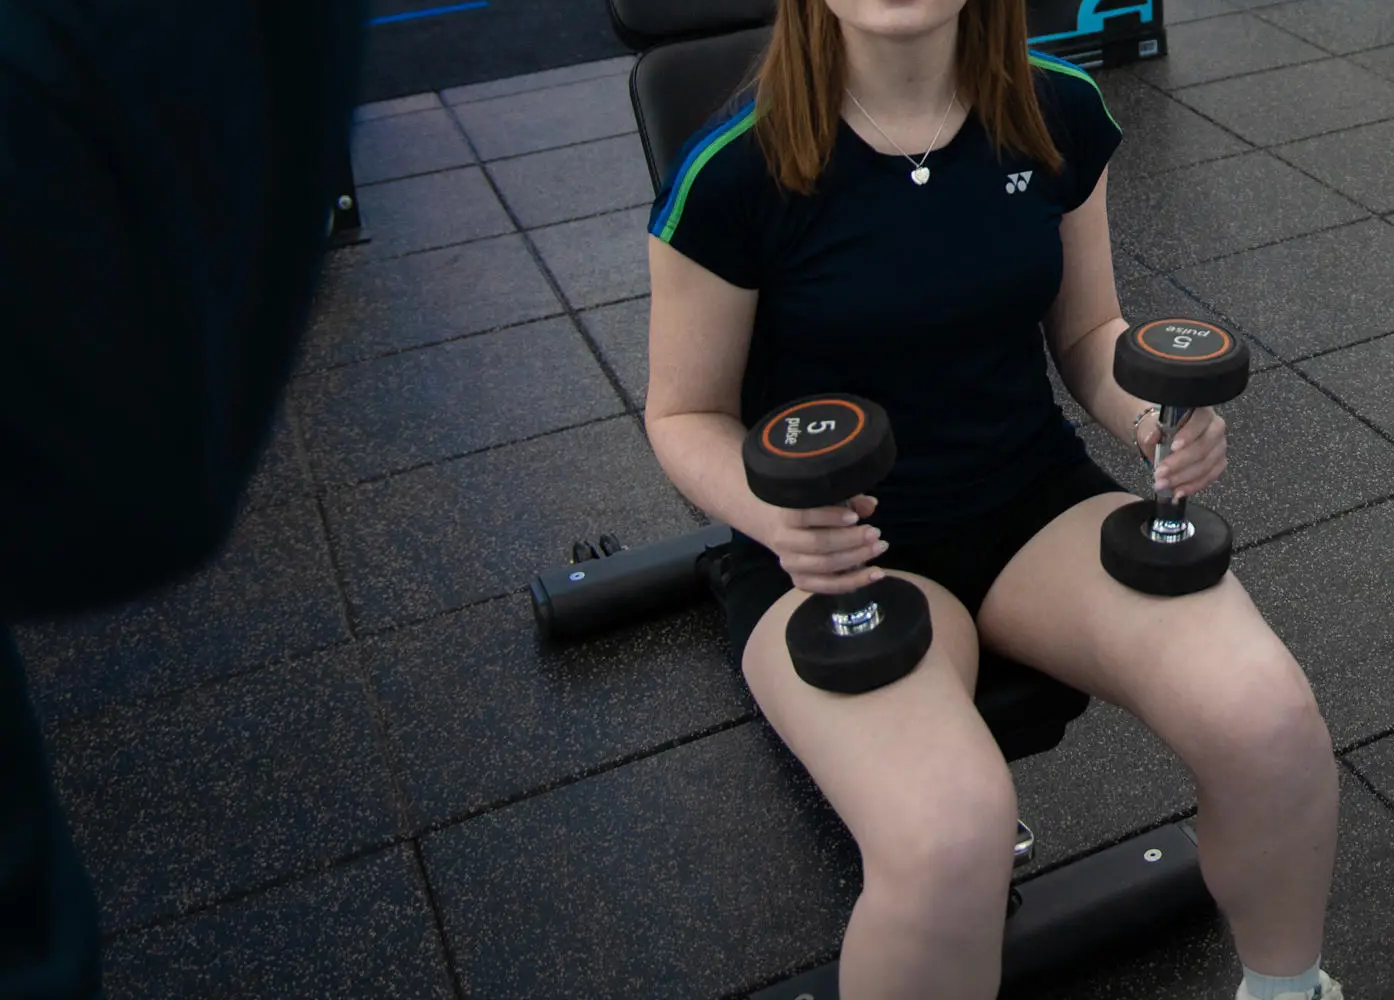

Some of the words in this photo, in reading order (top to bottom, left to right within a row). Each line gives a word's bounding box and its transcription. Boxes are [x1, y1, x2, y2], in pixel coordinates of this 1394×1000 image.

[1165, 325, 1211, 338] pulse
[1171, 335, 1193, 349] 5
[785, 417, 802, 446] pulse
[807, 420, 836, 435] 5
